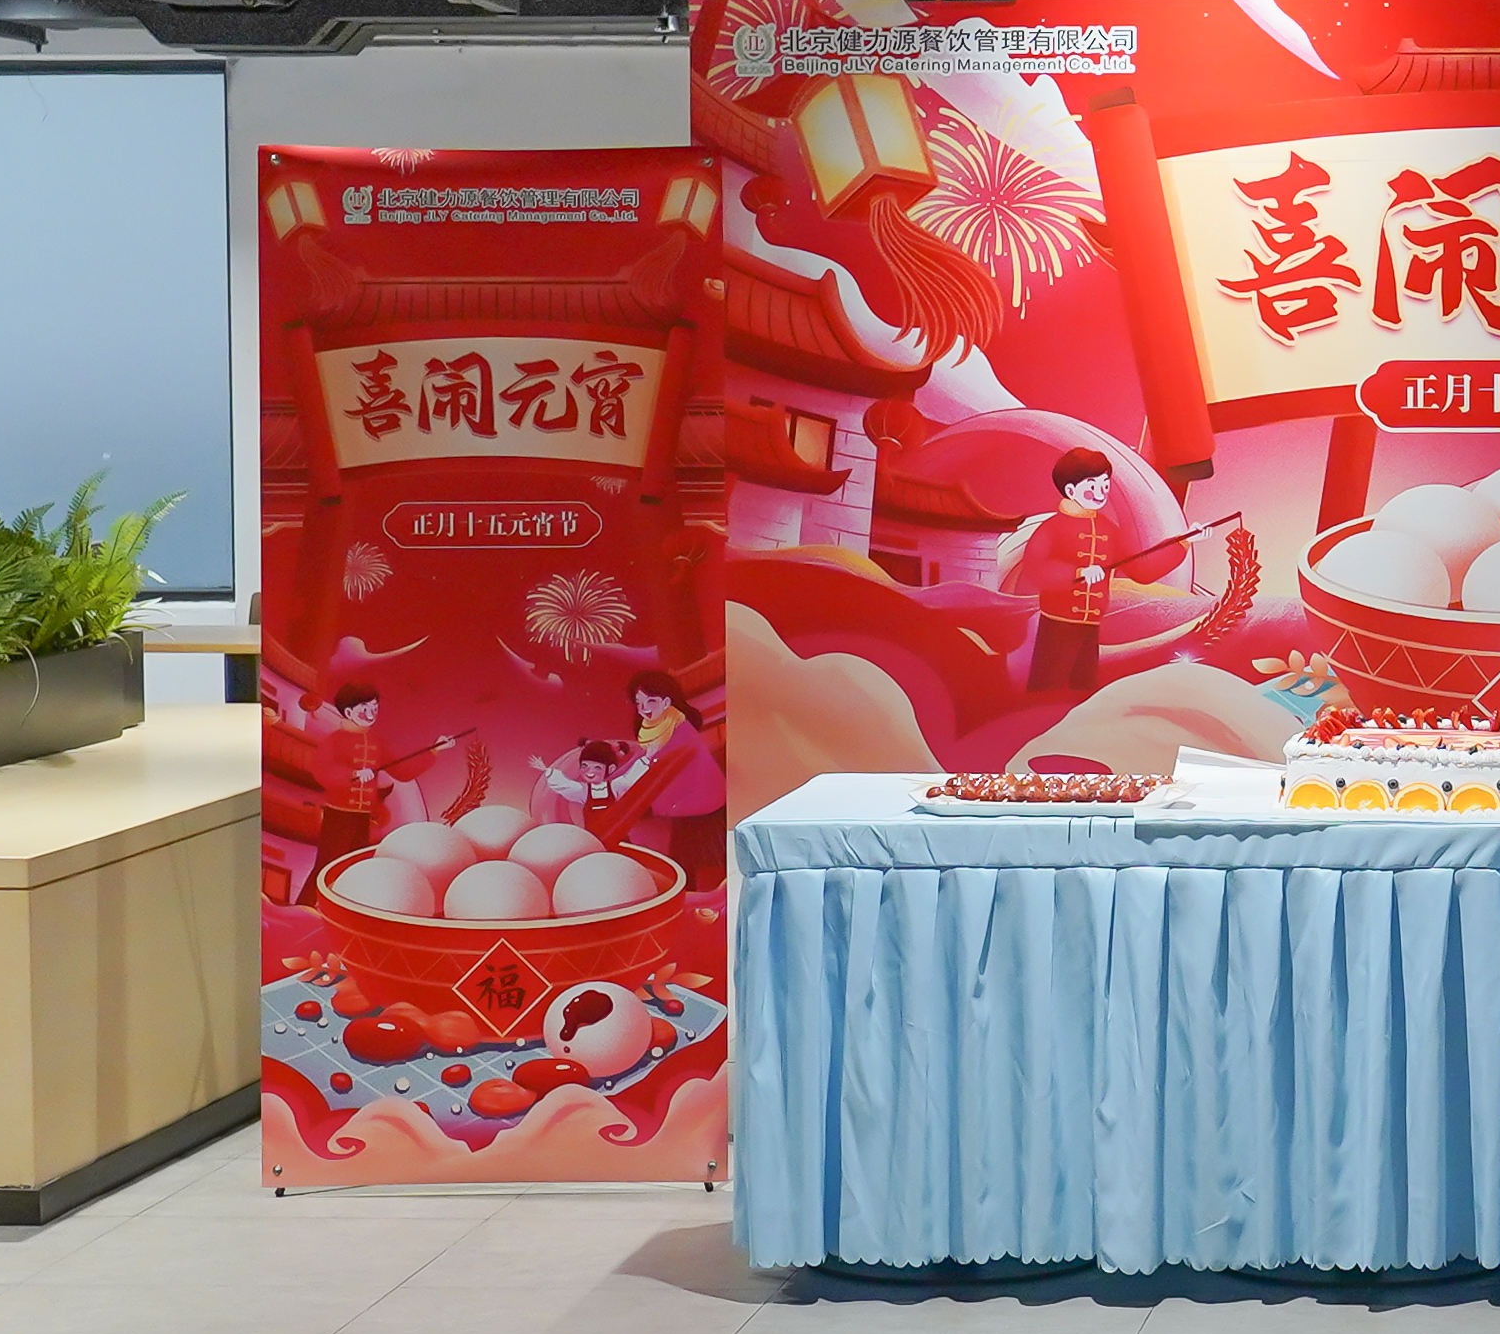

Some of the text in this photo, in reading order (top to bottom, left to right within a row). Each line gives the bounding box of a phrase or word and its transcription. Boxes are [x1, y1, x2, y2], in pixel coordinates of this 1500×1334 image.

[783, 28, 1134, 53] 北京健力源餐饮管理有限公司
[784, 58, 838, 75] Beijing
[845, 58, 875, 71] JLY
[883, 58, 950, 74] Catering
[957, 57, 1062, 74] Management
[378, 188, 639, 208] 北京健力源餐饮管理有限公司
[379, 210, 421, 224] Beijing
[345, 350, 645, 441] 喜闹元宵
[412, 511, 578, 538] 正月十五元宵节
[476, 963, 526, 1012] 福
